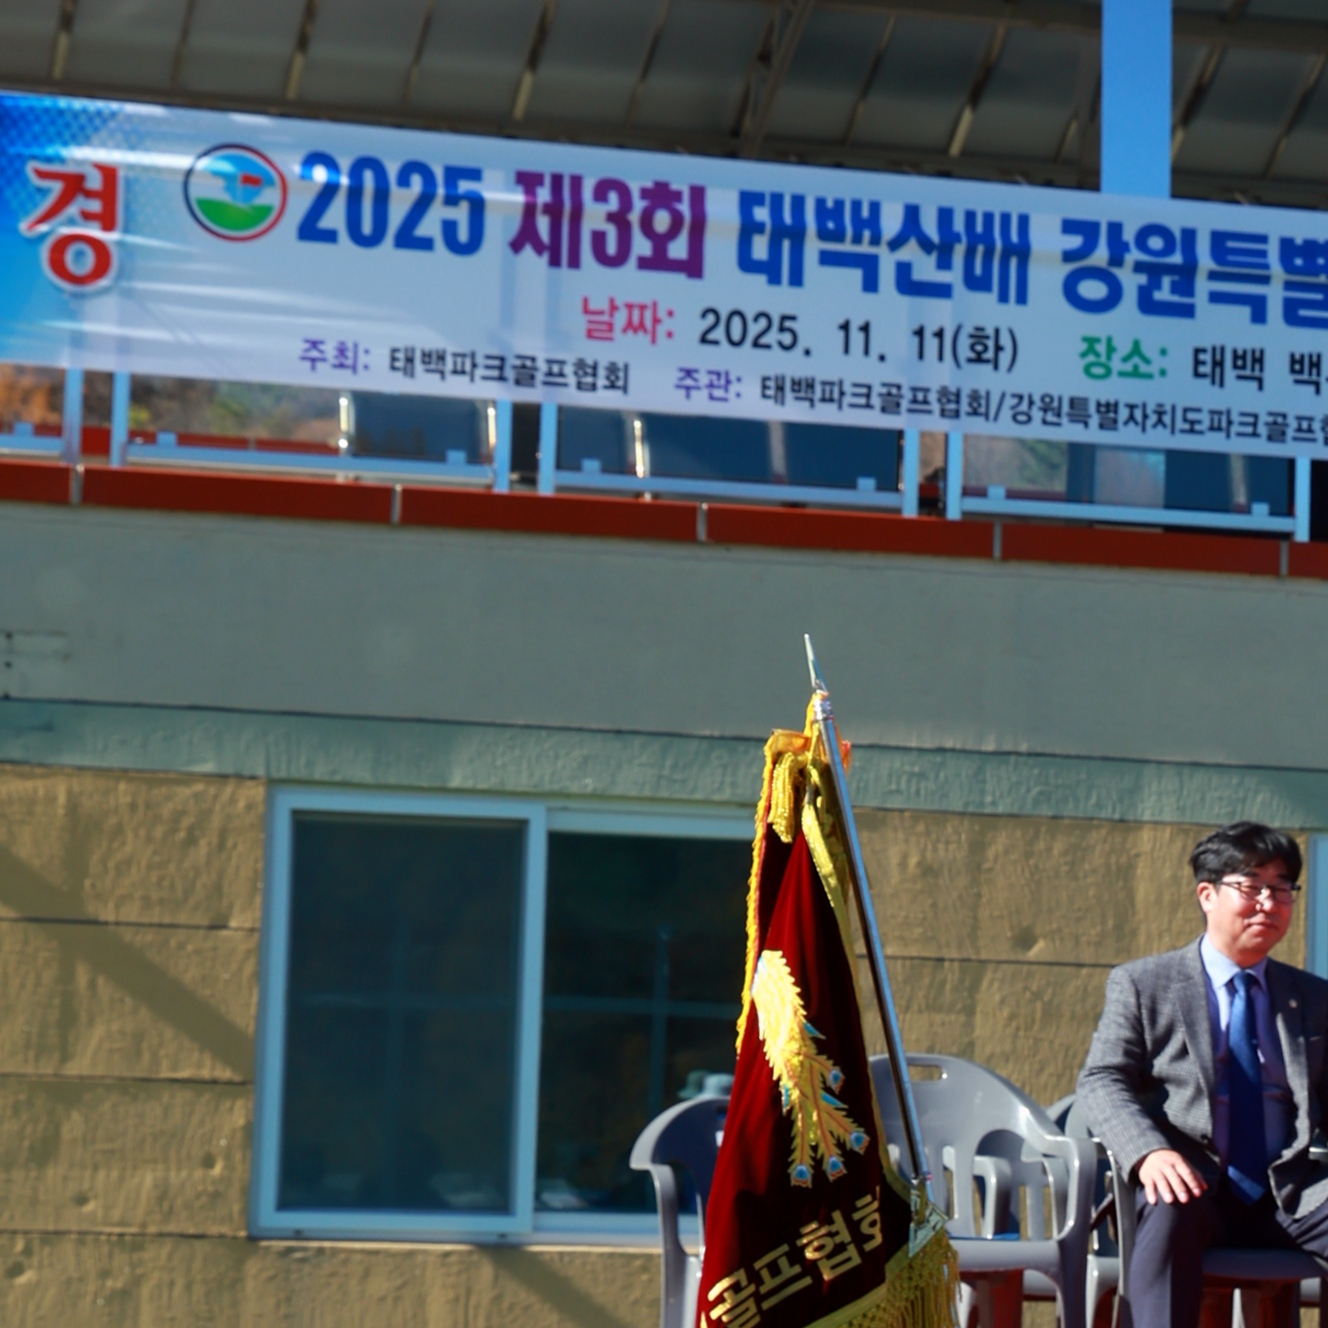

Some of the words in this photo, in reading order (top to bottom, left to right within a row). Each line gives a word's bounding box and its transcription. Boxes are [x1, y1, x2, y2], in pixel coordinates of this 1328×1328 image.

[21, 161, 119, 285] 경
[298, 151, 486, 256] 2025
[510, 170, 708, 279] 제3회
[736, 189, 1031, 306] 태백산배
[299, 339, 370, 374] 주최:
[388, 346, 630, 395] 태백파크골프협회
[674, 368, 742, 402] 주관:
[582, 296, 675, 345] 날짜:
[699, 309, 812, 358] 2025.
[838, 320, 887, 362] 11.
[912, 324, 1018, 373] 11(화)
[1078, 334, 1169, 381] 장소:
[1192, 345, 1266, 391] 태백
